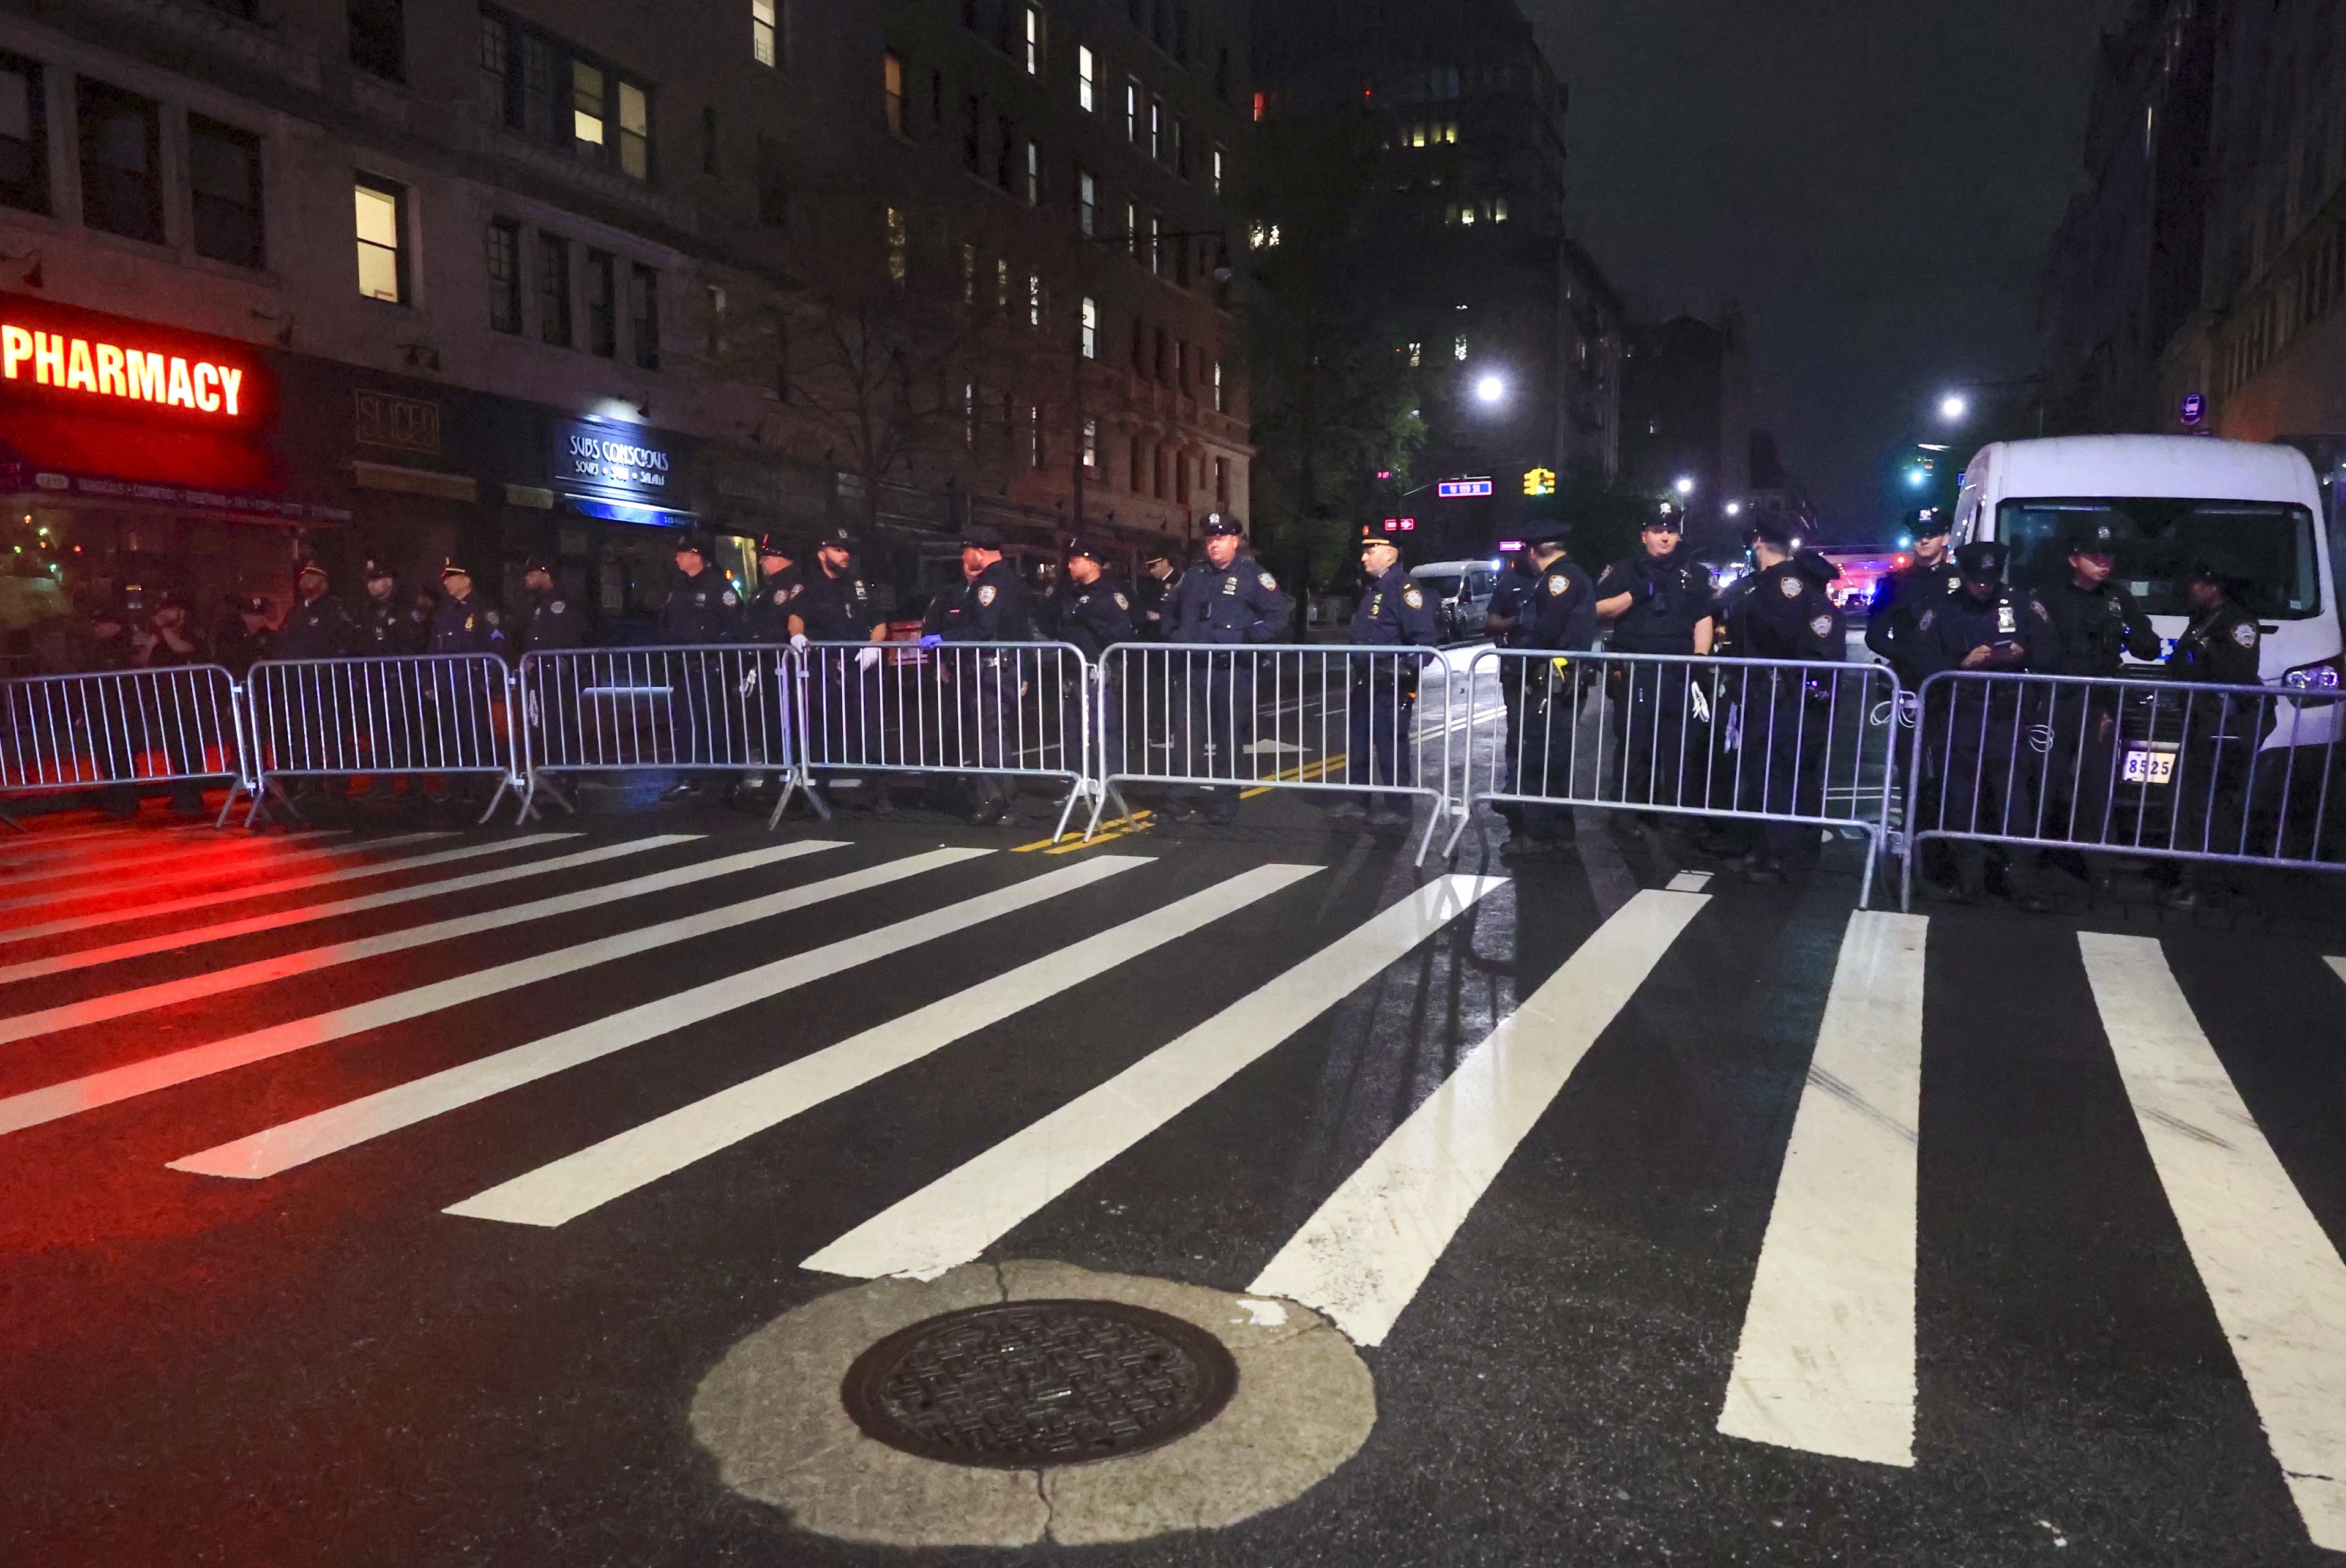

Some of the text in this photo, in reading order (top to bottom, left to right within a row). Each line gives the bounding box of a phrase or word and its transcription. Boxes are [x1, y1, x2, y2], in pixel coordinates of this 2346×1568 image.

[1, 324, 242, 416] PHARMACY
[570, 435, 669, 471] SUBS CONSCIOUS
[575, 460, 599, 475] SOUPS
[1449, 485, 1457, 494] W
[1459, 484, 1471, 493] 119
[2129, 759, 2169, 775] 8525
